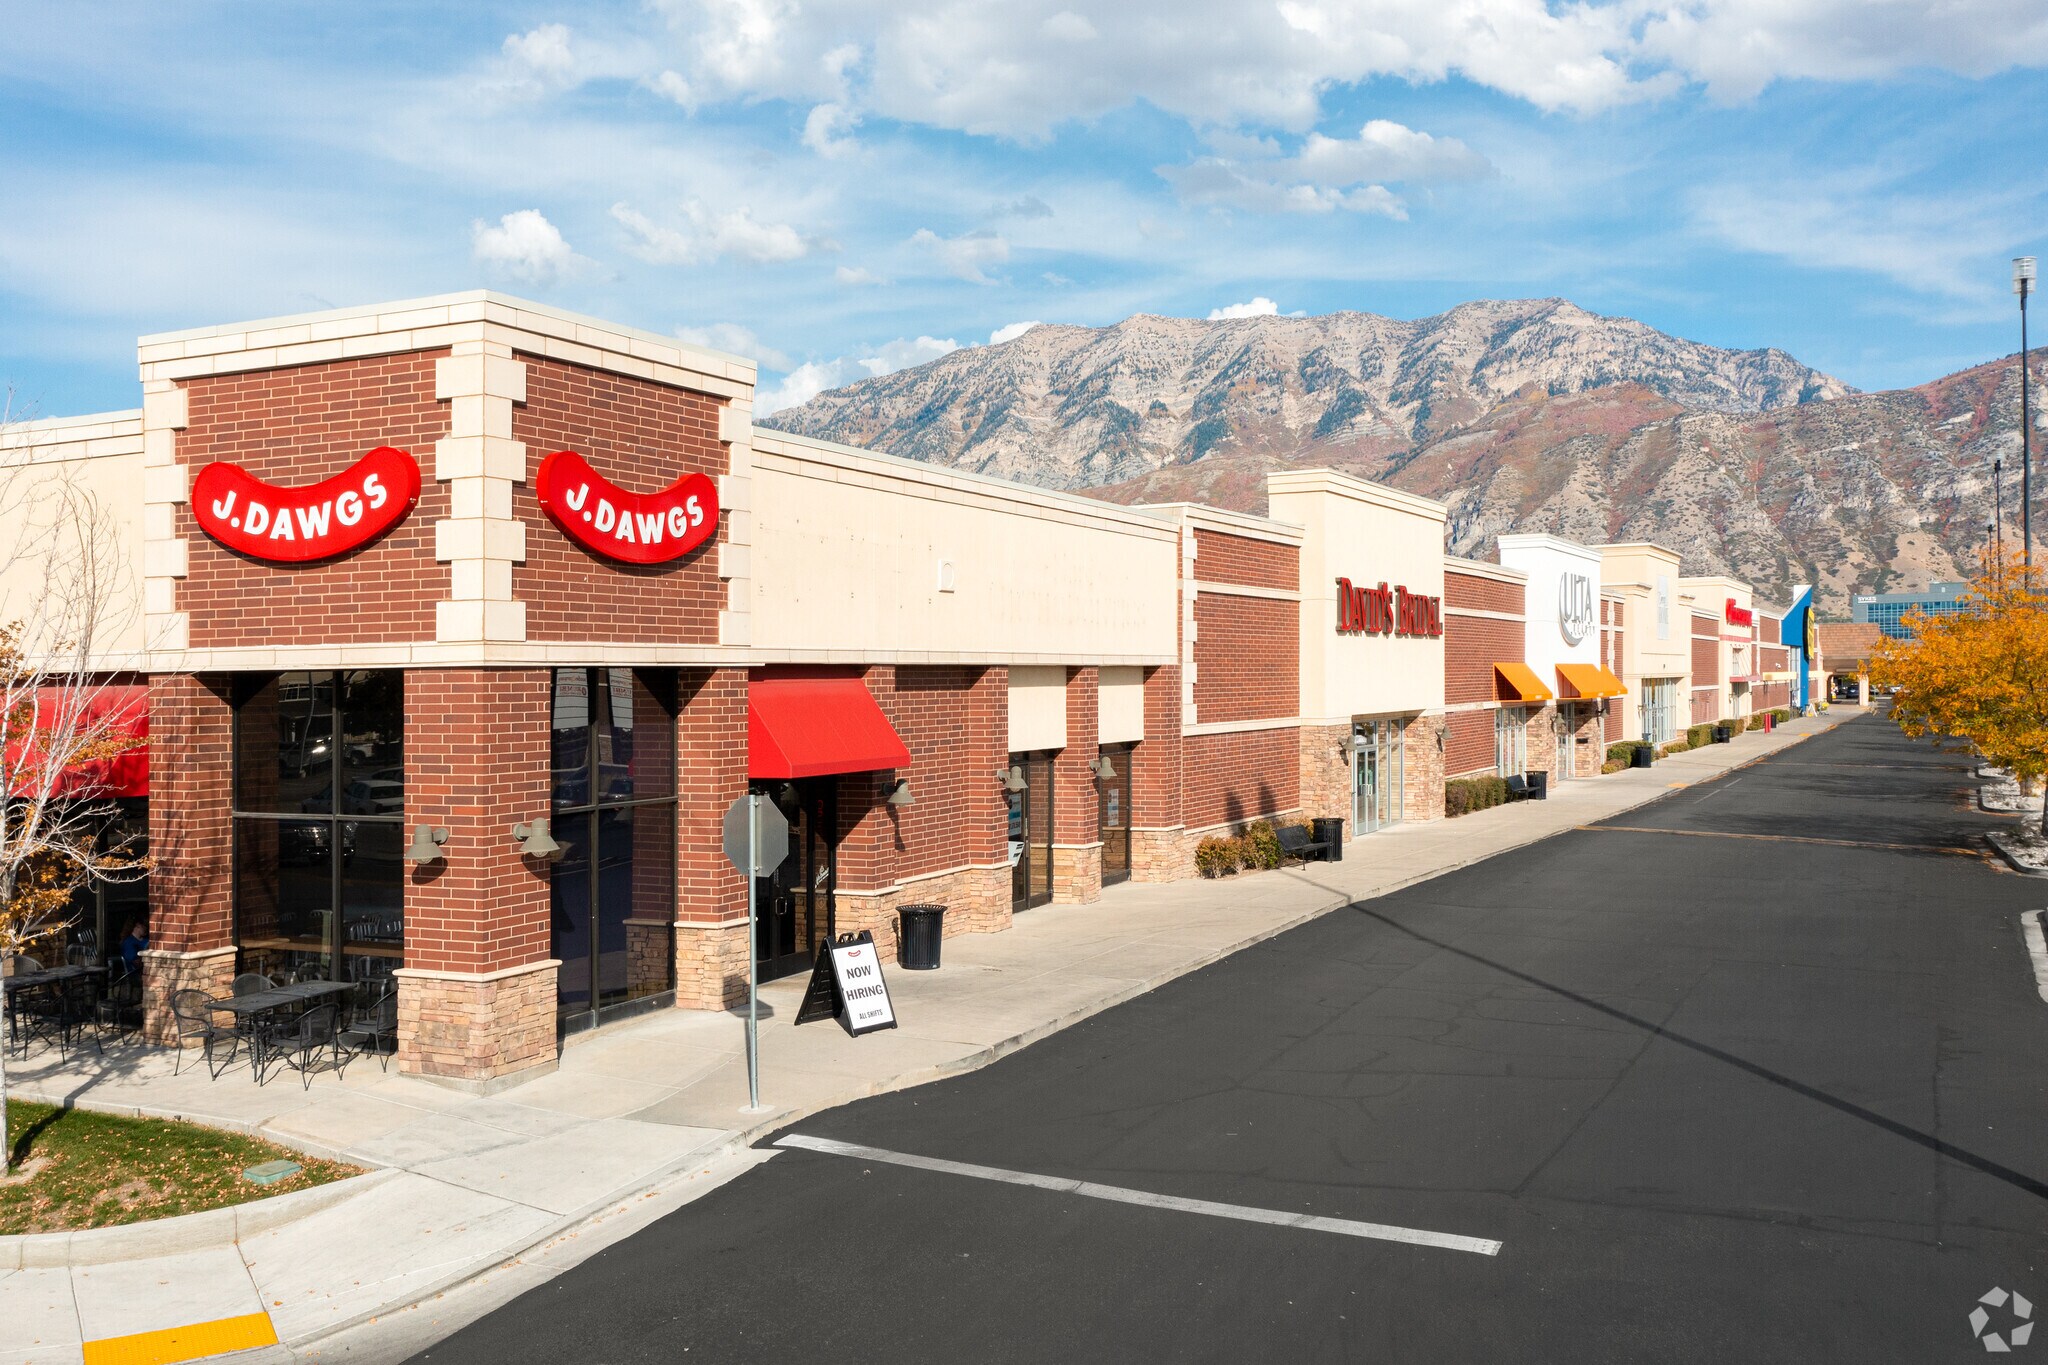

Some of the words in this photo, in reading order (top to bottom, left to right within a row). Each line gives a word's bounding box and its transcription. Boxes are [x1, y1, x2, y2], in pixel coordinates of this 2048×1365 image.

[212, 473, 388, 541] J.DAWGS
[566, 483, 704, 544] J.DAWGS
[1335, 577, 1394, 637] DAVID'S
[1394, 585, 1443, 639] BRIDAL
[1563, 572, 1593, 623] ULTA
[845, 984, 884, 1001] HIRING
[846, 965, 871, 979] NOW
[859, 1012, 868, 1020] ALL
[867, 1009, 883, 1018] SHIFTS
